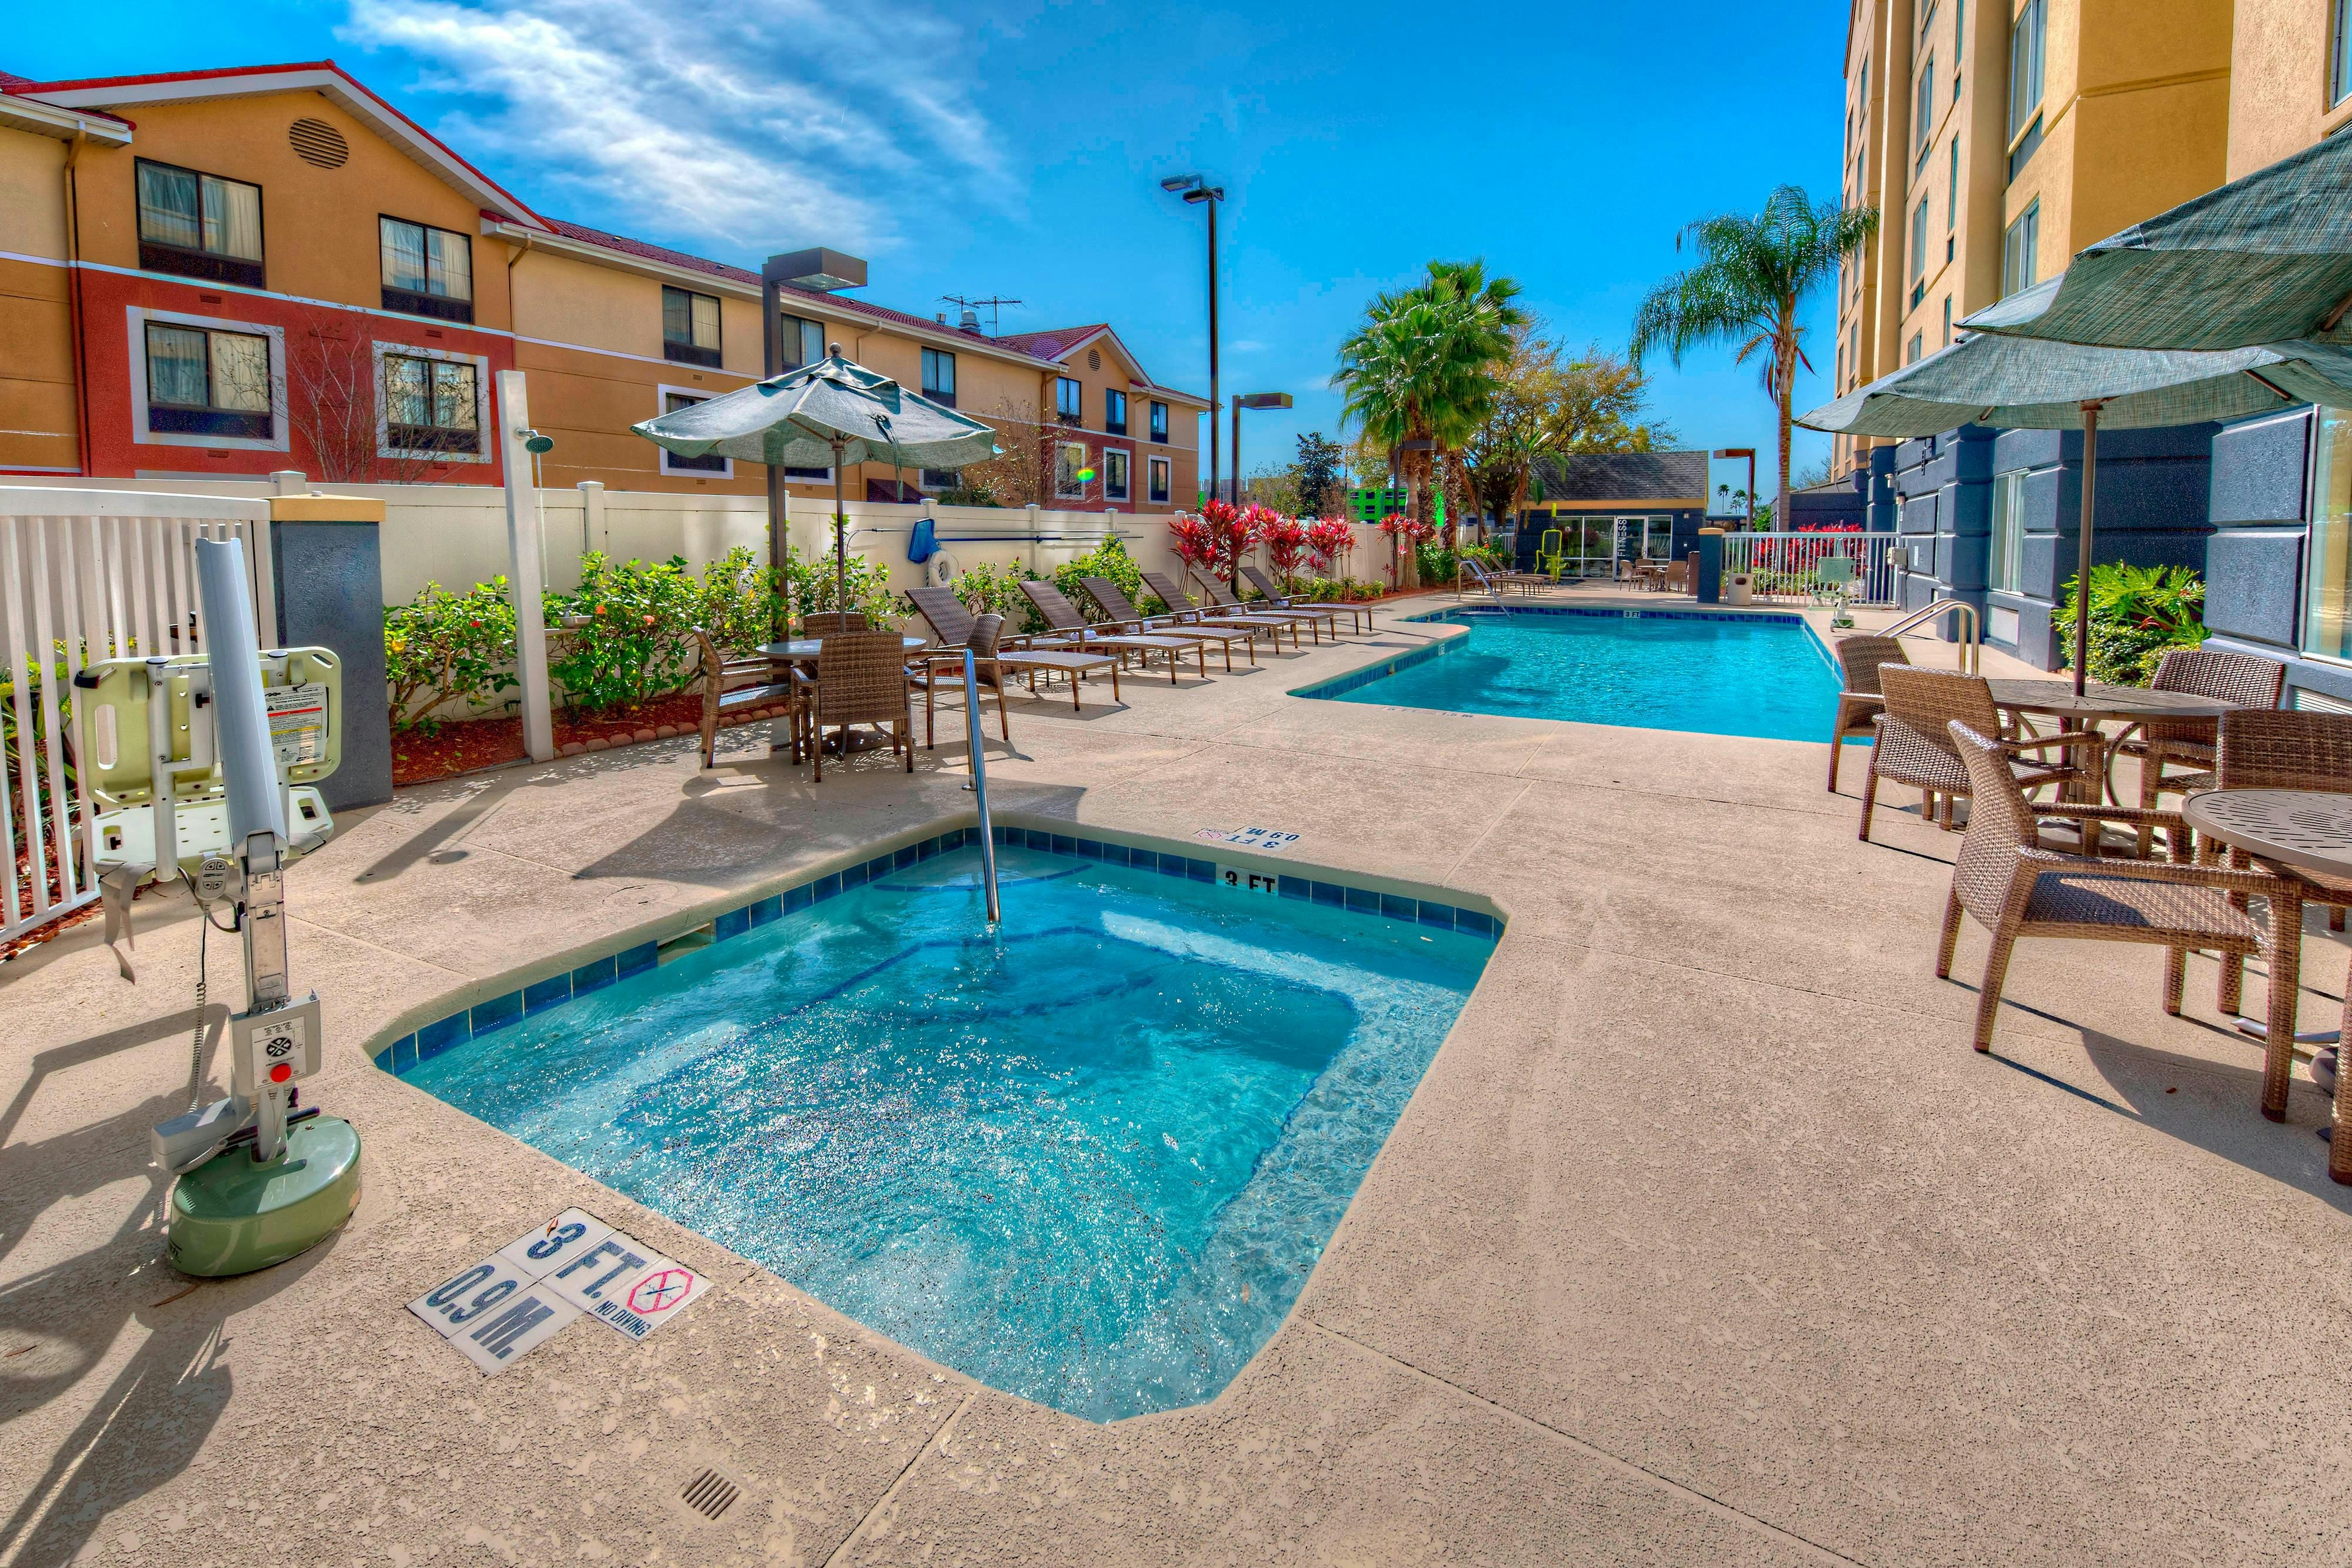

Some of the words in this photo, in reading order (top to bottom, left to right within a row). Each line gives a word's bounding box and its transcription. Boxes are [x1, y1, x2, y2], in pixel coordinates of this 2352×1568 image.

[1618, 519, 1627, 556] FITNESS
[1269, 832, 1299, 841] 0.9
[1225, 871, 1237, 886] 3
[527, 1223, 586, 1259] 3
[556, 1241, 646, 1299] FT.
[426, 1265, 517, 1323] 0.9
[470, 1296, 555, 1359] M.
[596, 1300, 613, 1318] NO
[610, 1309, 651, 1337] DIVING
